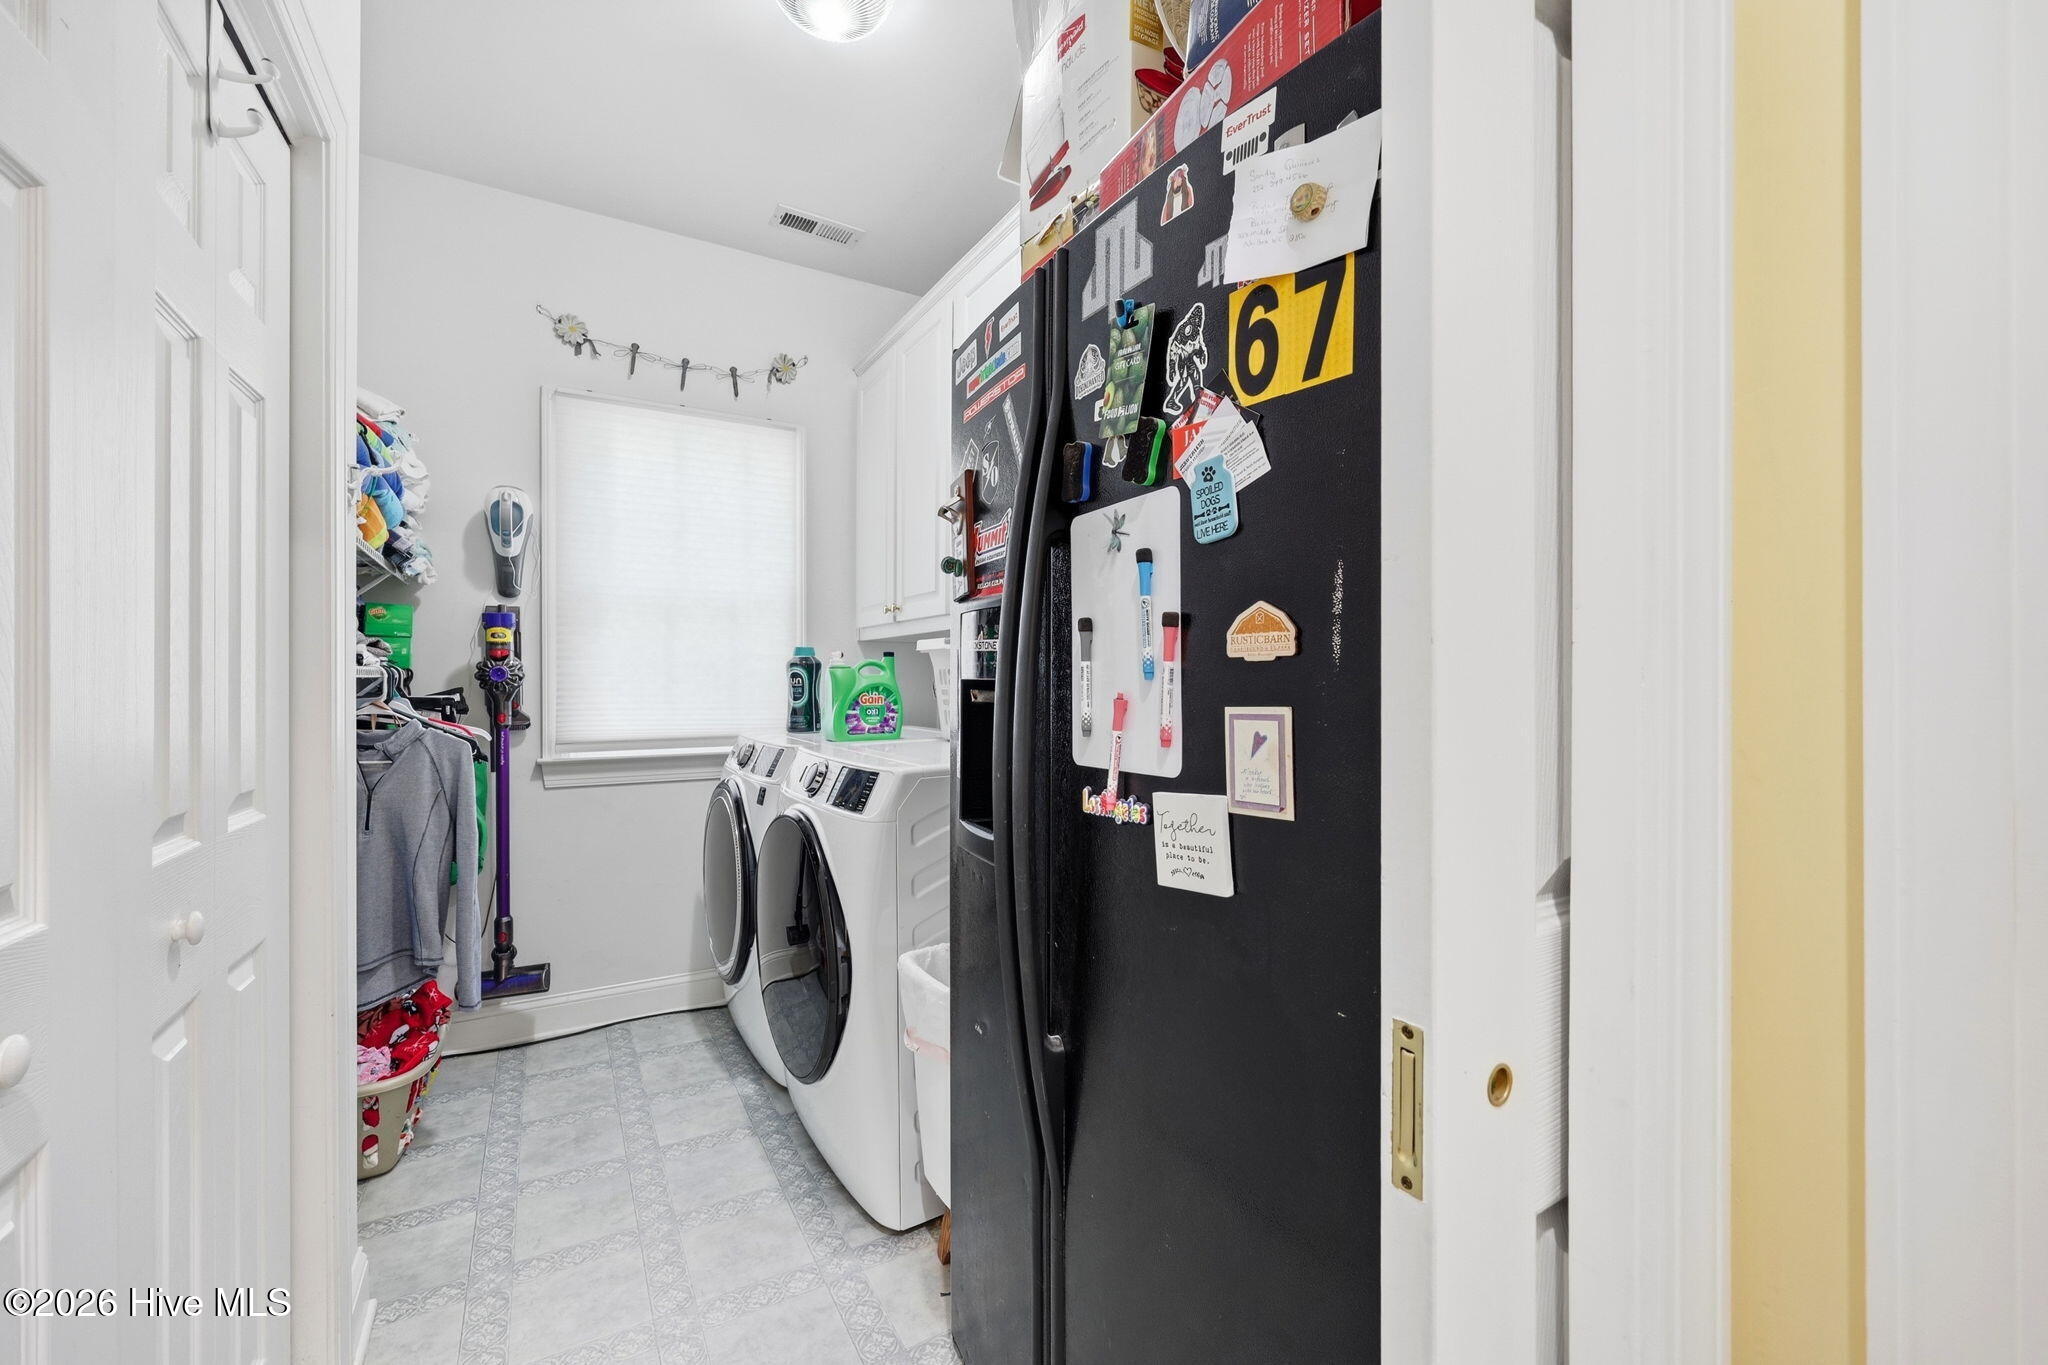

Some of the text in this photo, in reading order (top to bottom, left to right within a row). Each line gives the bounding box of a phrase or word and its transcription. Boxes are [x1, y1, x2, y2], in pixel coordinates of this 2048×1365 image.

[1225, 103, 1272, 138] EverTrust
[1195, 481, 1224, 500] SPOILED
[1200, 494, 1220, 510] DOGS
[1196, 521, 1229, 540] LIVE HERE
[860, 694, 884, 705] Gain
[1157, 810, 1216, 841] Together
[1179, 843, 1213, 854] beautiful
[1165, 852, 1184, 860] place
[1198, 856, 1210, 864] be.
